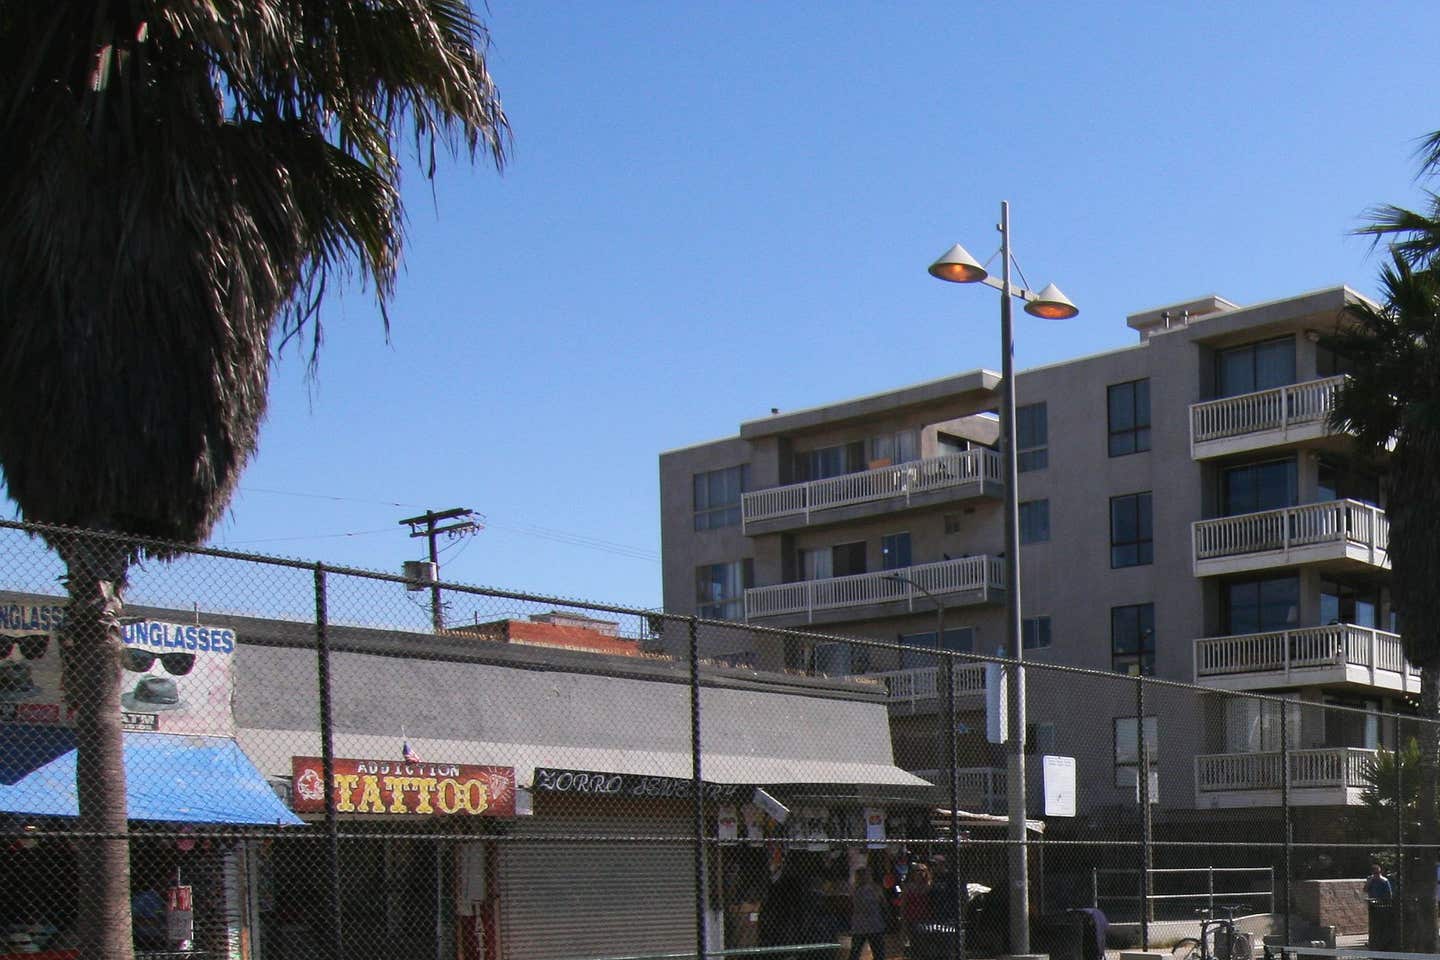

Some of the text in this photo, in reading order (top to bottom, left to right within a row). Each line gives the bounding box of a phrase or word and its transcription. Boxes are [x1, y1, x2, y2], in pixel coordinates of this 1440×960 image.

[357, 761, 460, 777] ADDICTION
[538, 769, 738, 798] ZORRO JEWERY
[334, 774, 489, 815] TATTOO
